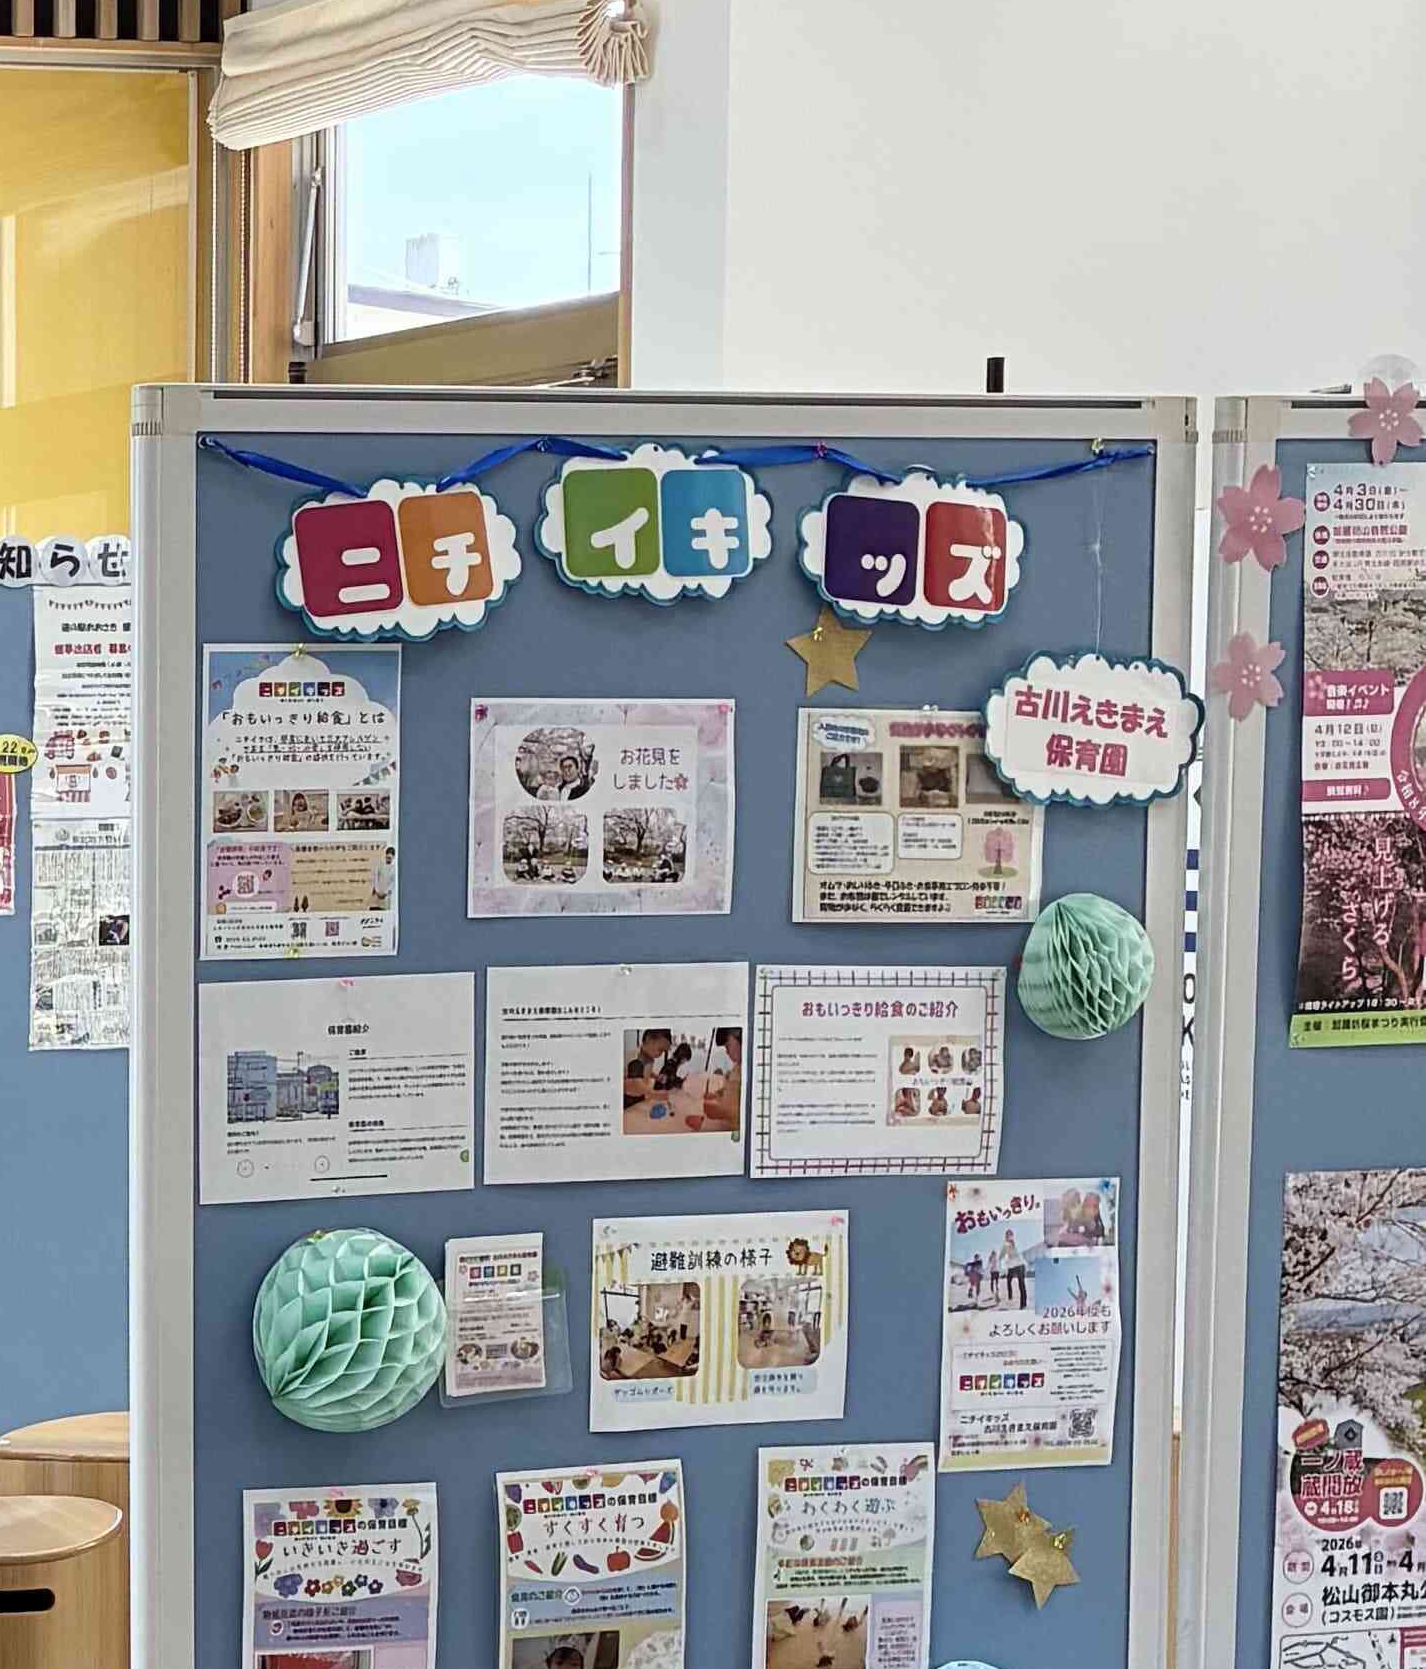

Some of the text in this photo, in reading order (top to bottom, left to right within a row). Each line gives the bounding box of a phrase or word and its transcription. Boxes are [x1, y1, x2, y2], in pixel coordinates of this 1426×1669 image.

[221, 710, 386, 726] 「おもいっきり給食」とは
[1014, 684, 1169, 739] 古川えきまえ
[619, 747, 682, 766] お花見を
[1045, 732, 1128, 778] 保育園
[613, 773, 675, 791] しました
[1373, 837, 1394, 946] 見上げる
[1341, 902, 1360, 981] さくら
[801, 999, 959, 1019] おもいっきり給食のご紹介
[649, 1248, 774, 1273] 避難訓練の様子
[988, 1319, 1112, 1339] よろしくお願いします
